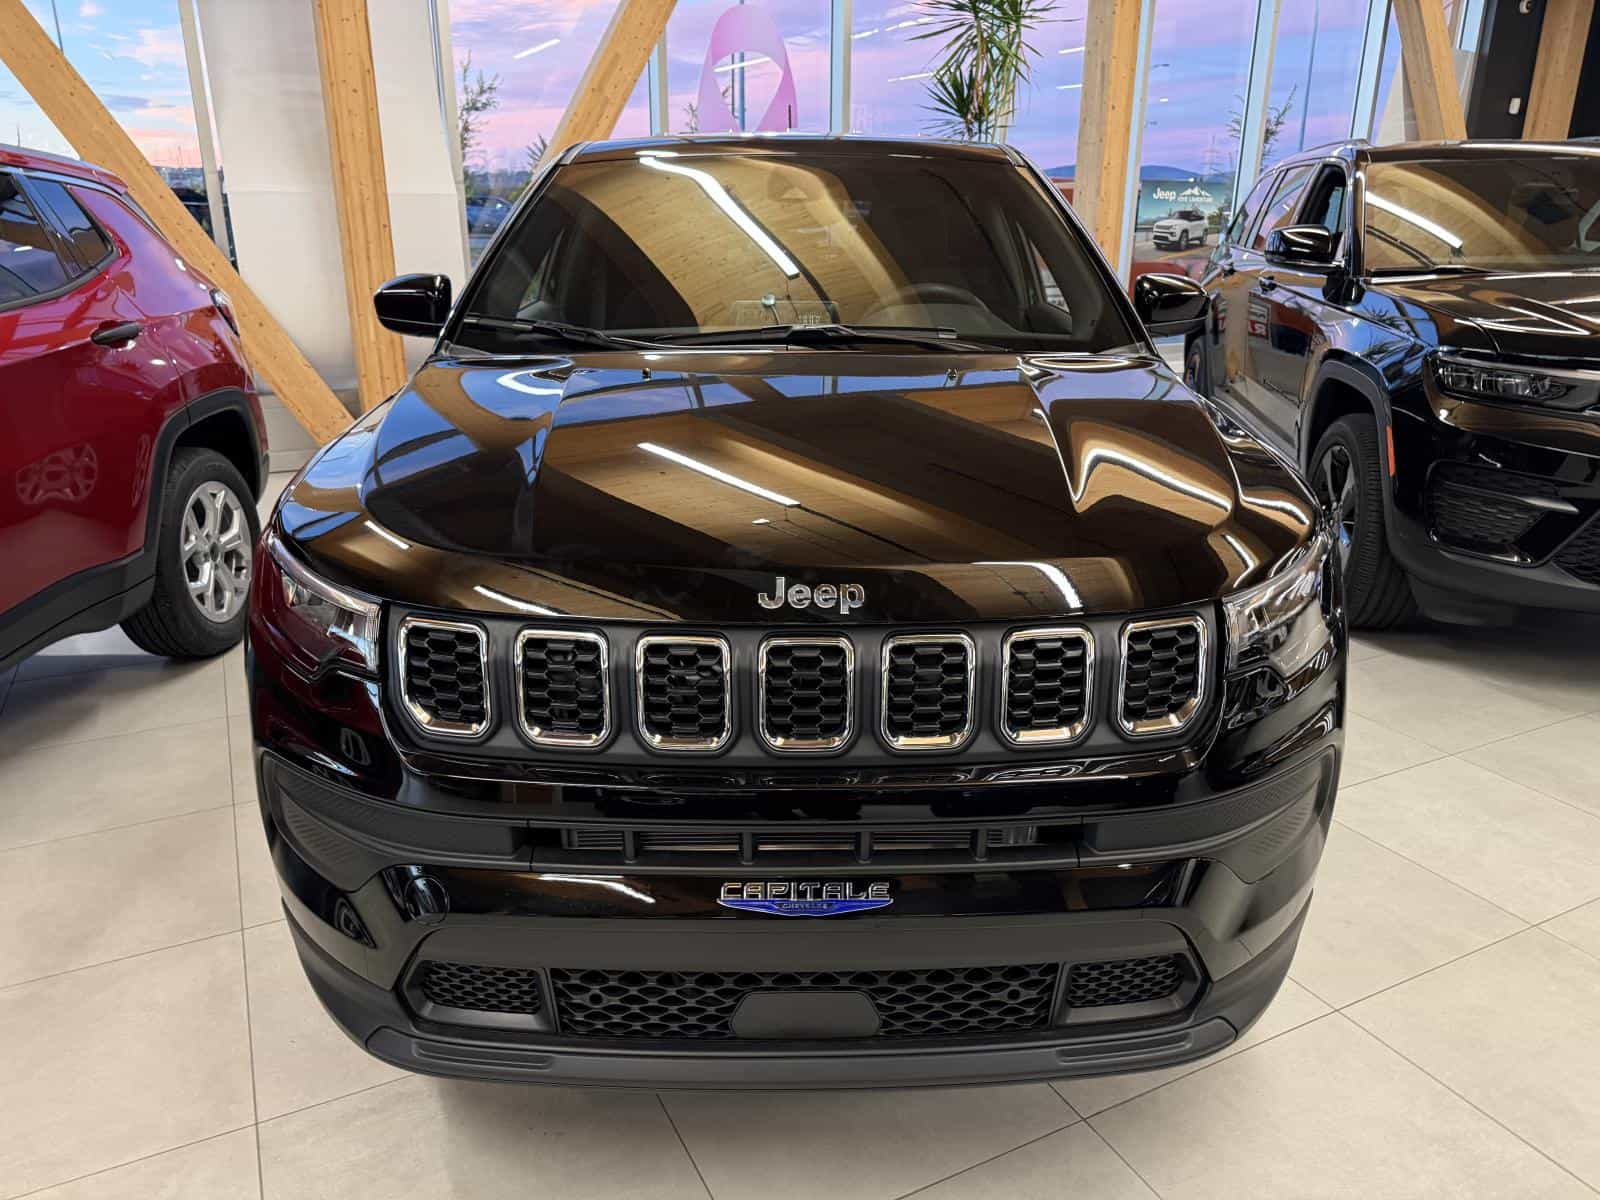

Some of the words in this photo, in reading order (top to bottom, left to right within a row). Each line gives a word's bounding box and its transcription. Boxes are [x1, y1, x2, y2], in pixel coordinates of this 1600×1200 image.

[1153, 187, 1176, 202] Jeep
[758, 576, 865, 614] Jeep
[720, 882, 891, 900] CAPITALE
